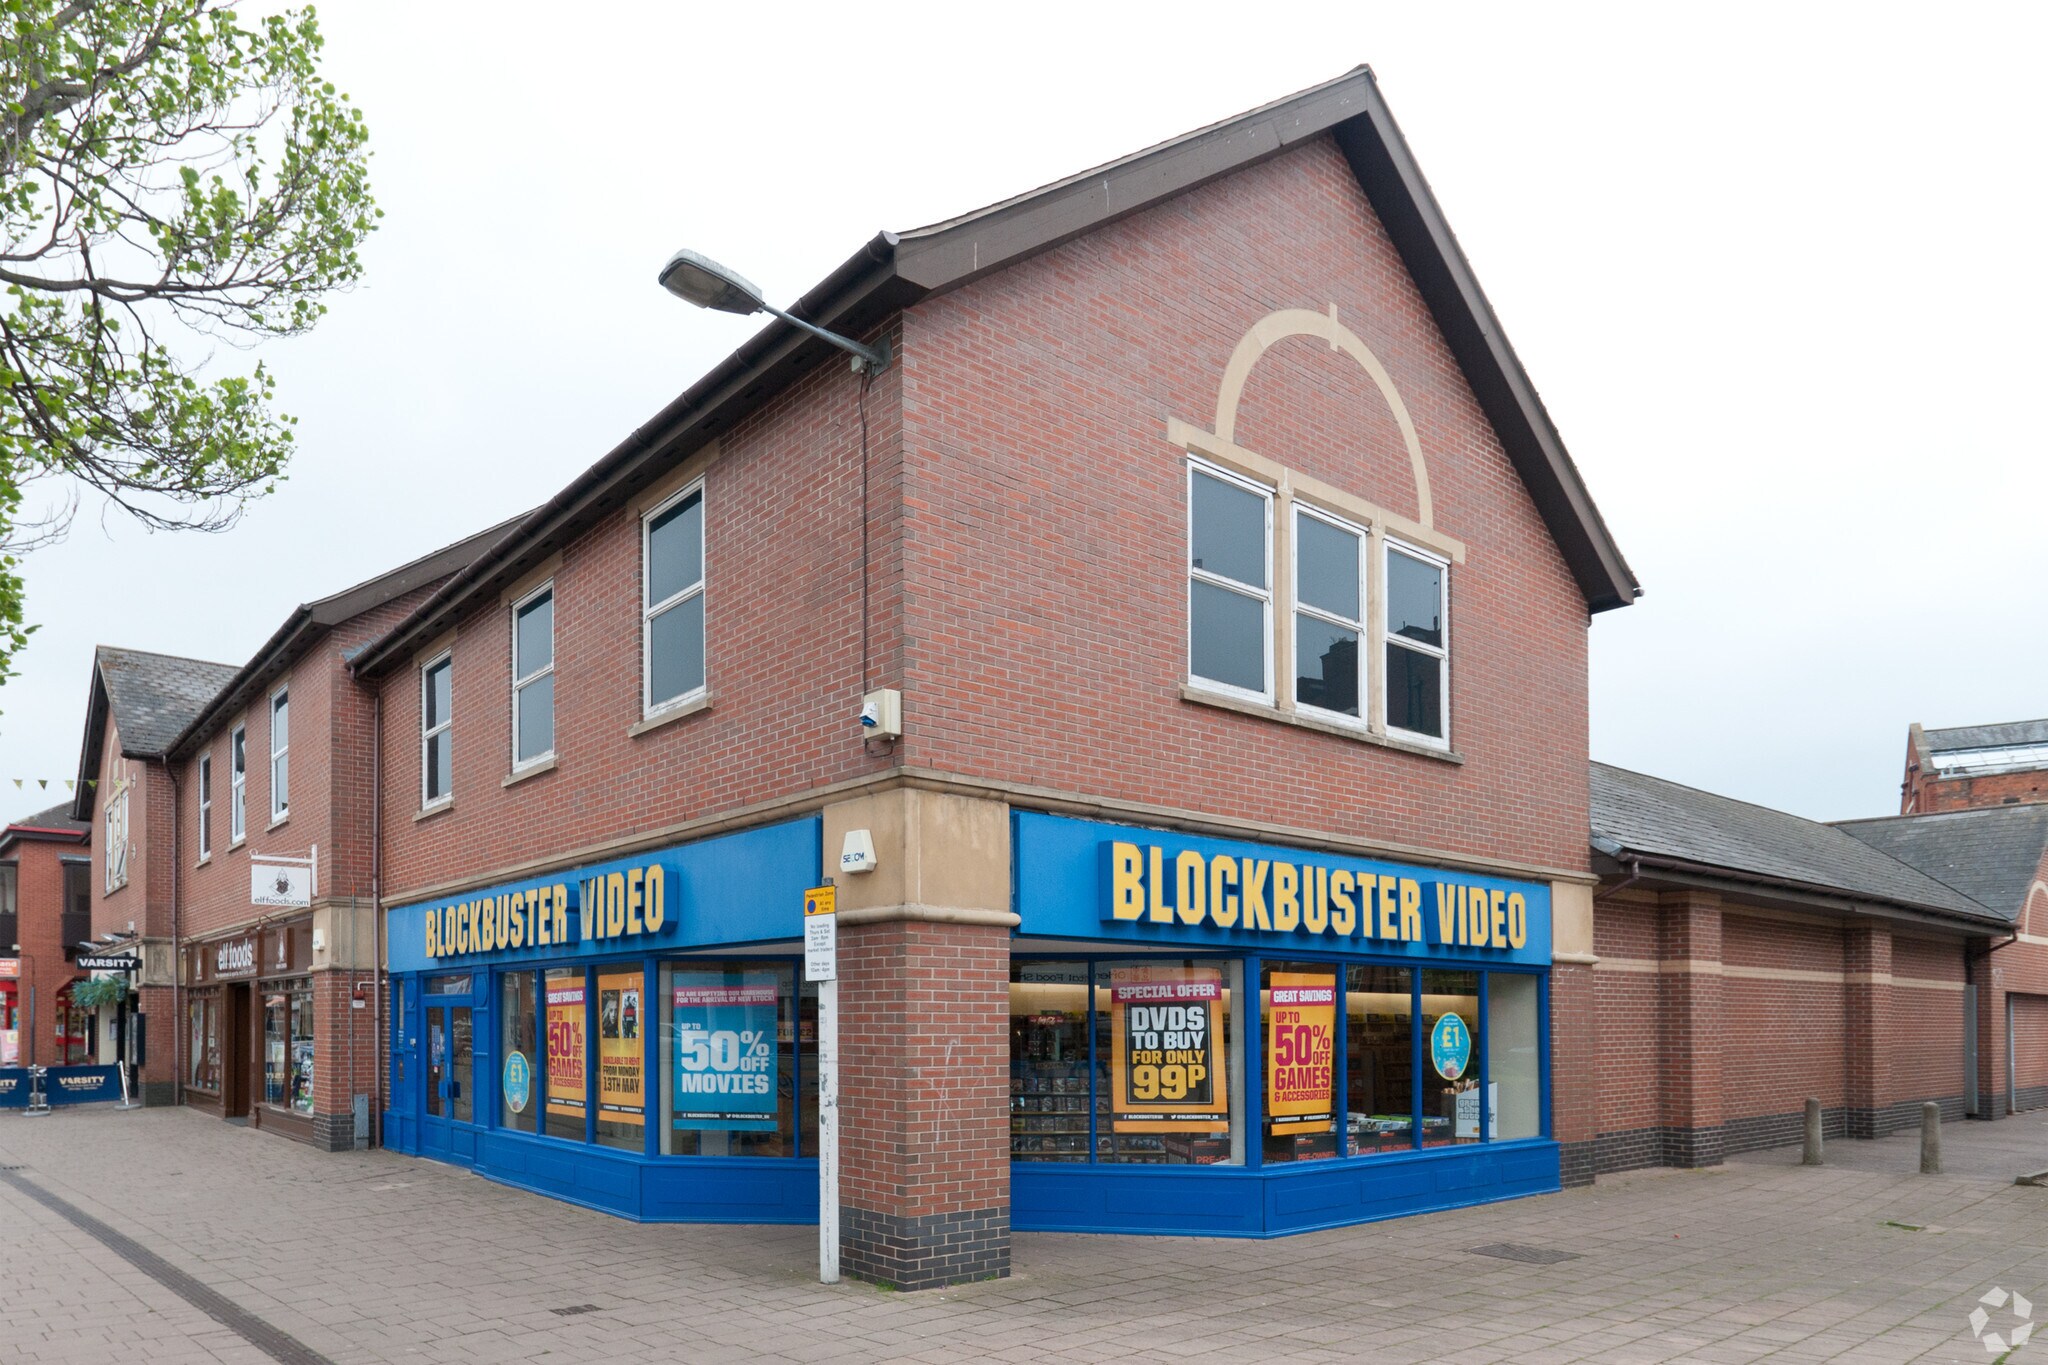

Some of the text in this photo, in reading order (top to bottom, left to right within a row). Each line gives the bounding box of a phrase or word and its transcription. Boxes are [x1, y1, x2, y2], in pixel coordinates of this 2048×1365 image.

[1113, 841, 1526, 949] BLOCKBUSTER VIDEO
[426, 864, 664, 958] BLOCKBUSTER VIDEO
[229, 938, 252, 968] foods
[79, 958, 135, 967] VARSITY
[548, 990, 583, 1003] GREAT SAVINGS
[1118, 984, 1215, 999] SPECIAL OFFER
[1274, 989, 1332, 1002] GREAT SAVINGS
[1131, 1006, 1205, 1031] DVDS
[1276, 1012, 1300, 1024] UP TO
[550, 1022, 582, 1057] 50%
[1132, 1032, 1204, 1050] TO BUY
[1442, 1026, 1460, 1047] £1
[573, 1045, 582, 1058] OFF
[682, 1030, 769, 1071] 50%
[1275, 1025, 1330, 1066] 50%
[603, 1057, 624, 1065] AVAILABLE
[740, 1057, 769, 1071] OFF
[1132, 1050, 1205, 1064] FOR ONLY
[1313, 1051, 1330, 1066] OFF
[550, 1057, 582, 1078] GAMES
[603, 1066, 640, 1078] FROM MONDAY
[59, 1076, 105, 1085] VARSITY
[554, 1078, 582, 1089] ACCESSORIES
[603, 1077, 640, 1094] 13TH MAY
[682, 1073, 769, 1094] MOVIES
[1133, 1065, 1206, 1100] 99P
[1275, 1066, 1330, 1090] GAMES
[1275, 1090, 1330, 1102] & ACCESSORIES
